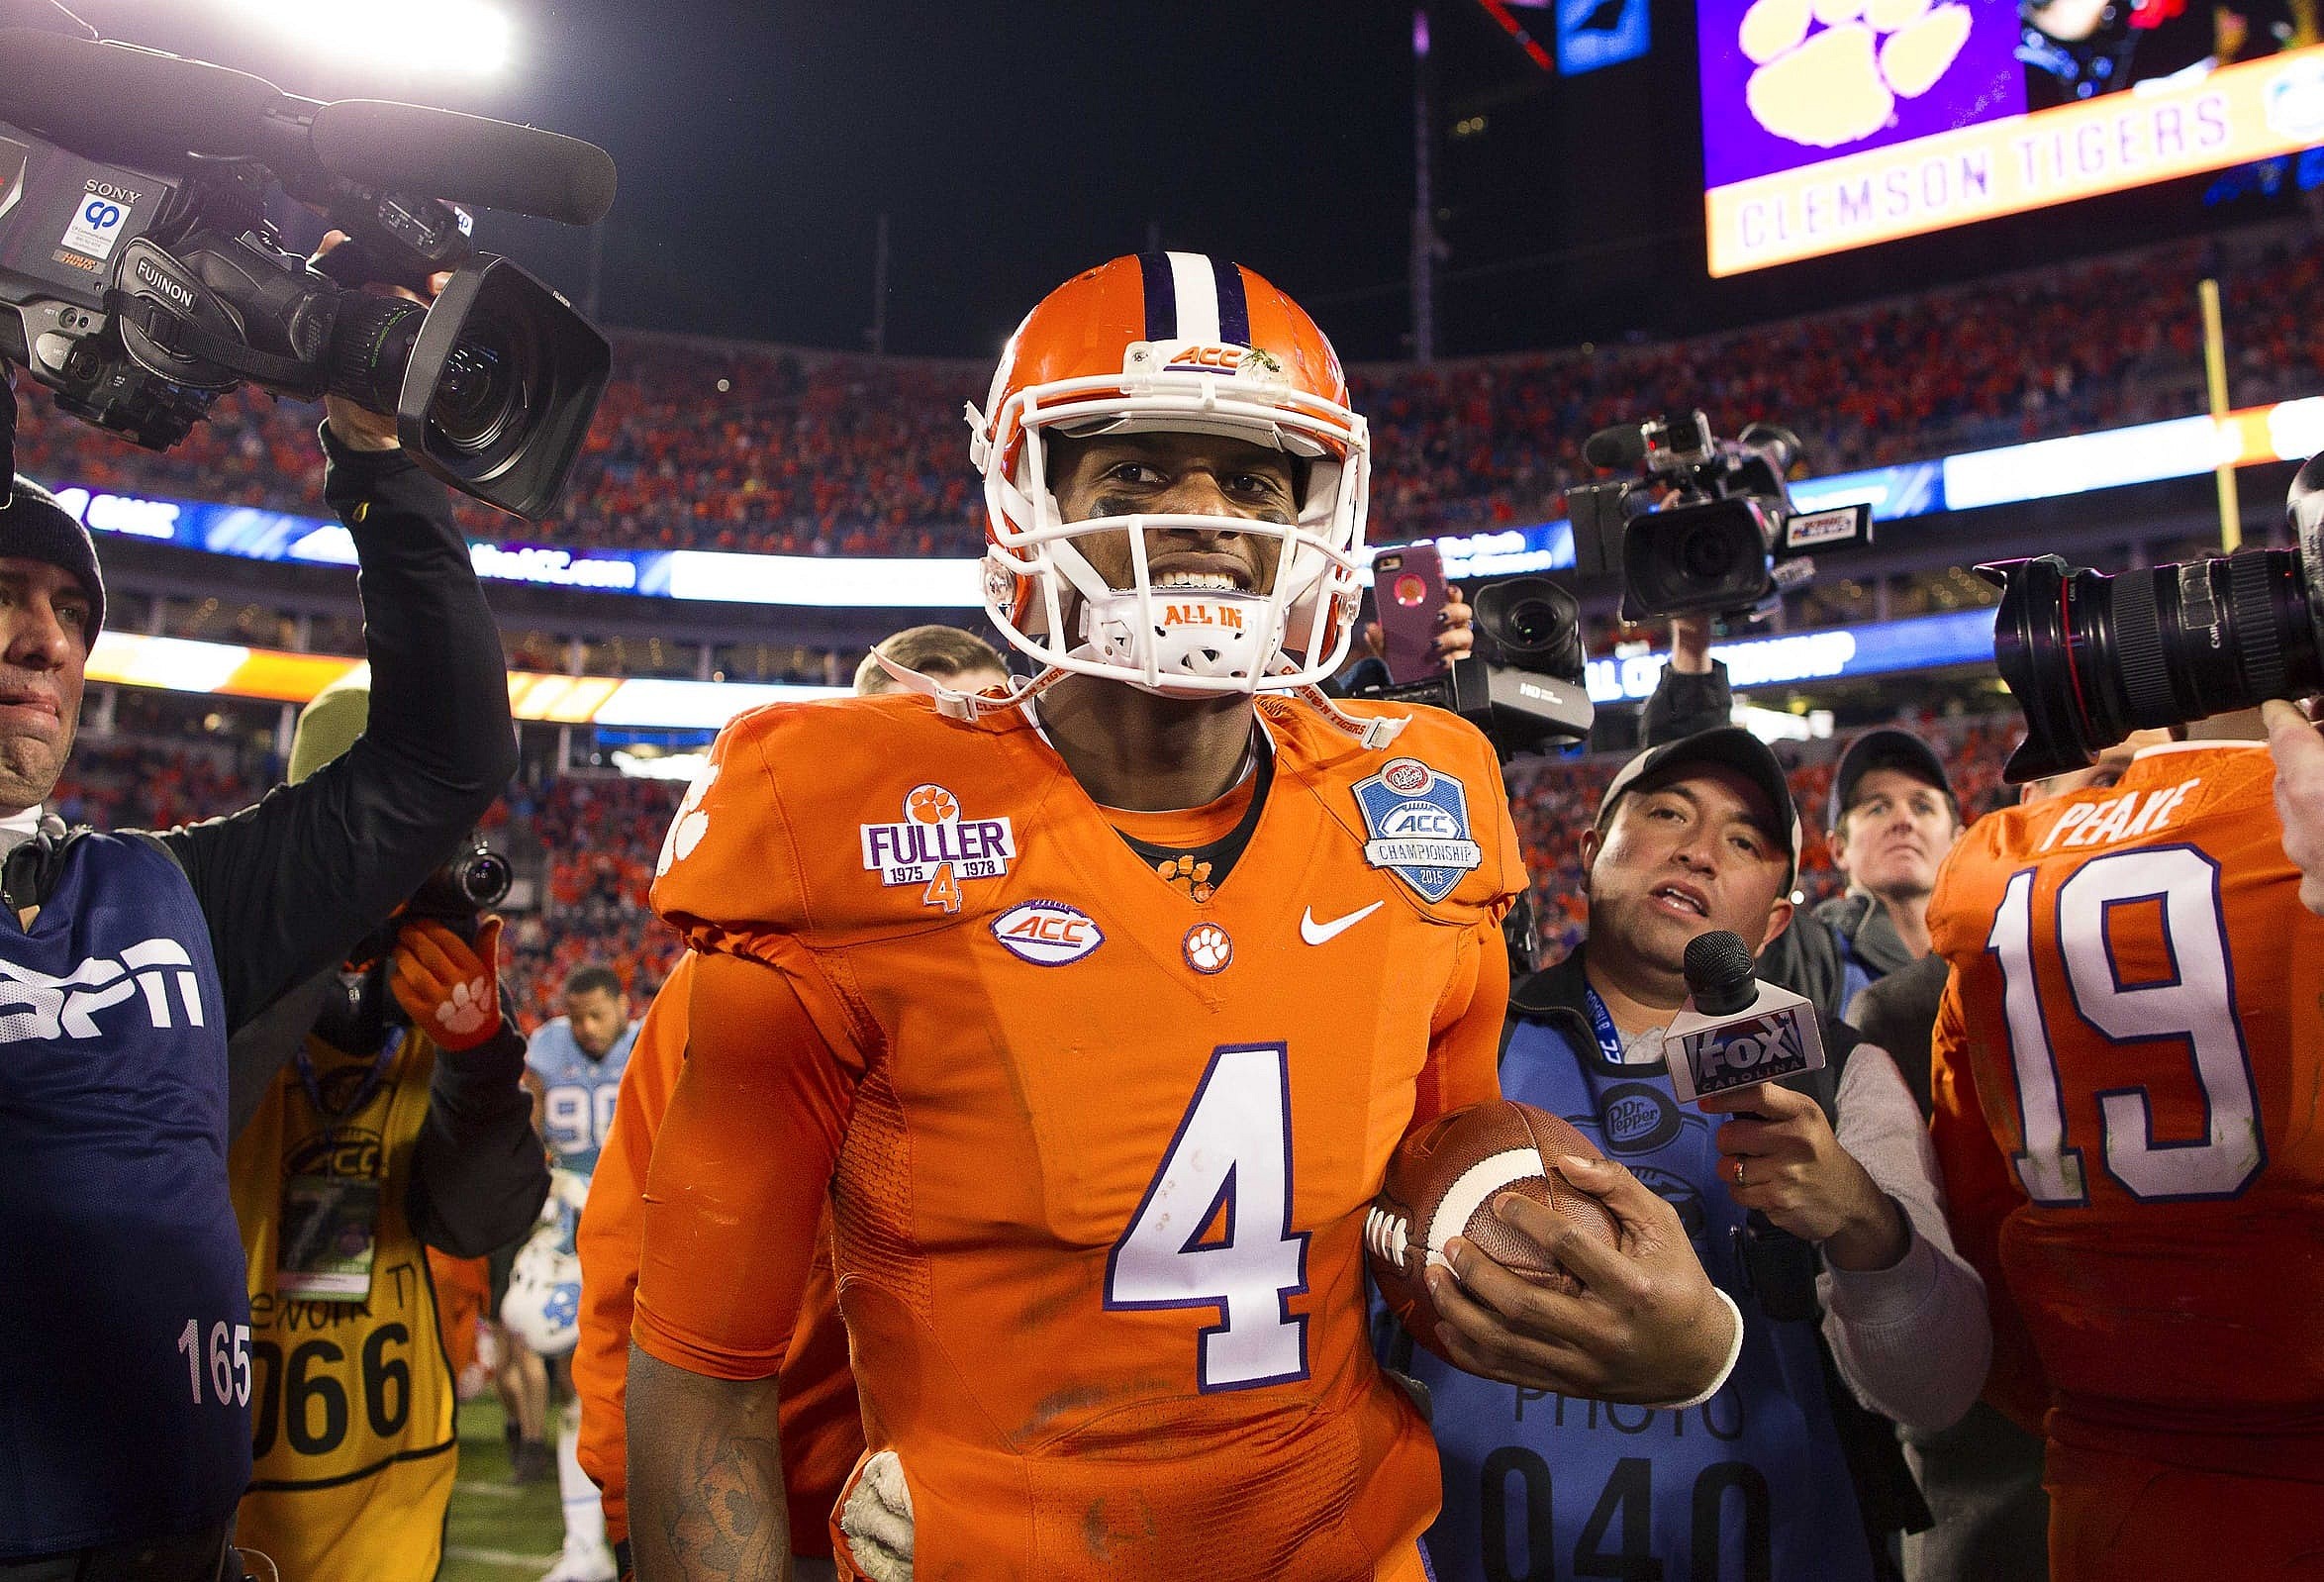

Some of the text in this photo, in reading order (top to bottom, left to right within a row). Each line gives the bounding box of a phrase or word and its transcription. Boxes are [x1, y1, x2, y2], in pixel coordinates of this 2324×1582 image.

[1740, 95, 2227, 250] CLEMSON TIGERS
[83, 178, 143, 205] SONY
[137, 259, 194, 307] FUJINON
[1170, 346, 1242, 369] ACC
[1164, 605, 1243, 630] ALL IN
[1036, 666, 1068, 688] TIGE
[1330, 713, 1366, 736] TIGERS
[1395, 815, 1450, 834] ACC
[2039, 777, 2201, 852] PEAKE
[868, 821, 1008, 867] FULLER
[1379, 843, 1472, 862] CHAMPIONSHIP
[890, 859, 997, 883] 1975 1978
[1419, 869, 1444, 885] 2015
[923, 861, 962, 915] 4
[1006, 915, 1091, 943] ACC
[0, 938, 206, 1044] SPN
[1986, 842, 2268, 1208] 19
[1698, 1014, 1793, 1079] FOX
[1700, 1059, 1804, 1093] CAROLINA
[1606, 1105, 1658, 1136] Pepper
[1622, 1100, 1645, 1115] Dr
[1103, 1041, 1310, 1394] 4
[178, 1318, 251, 1409] 165
[1481, 1445, 1773, 1582] 040
